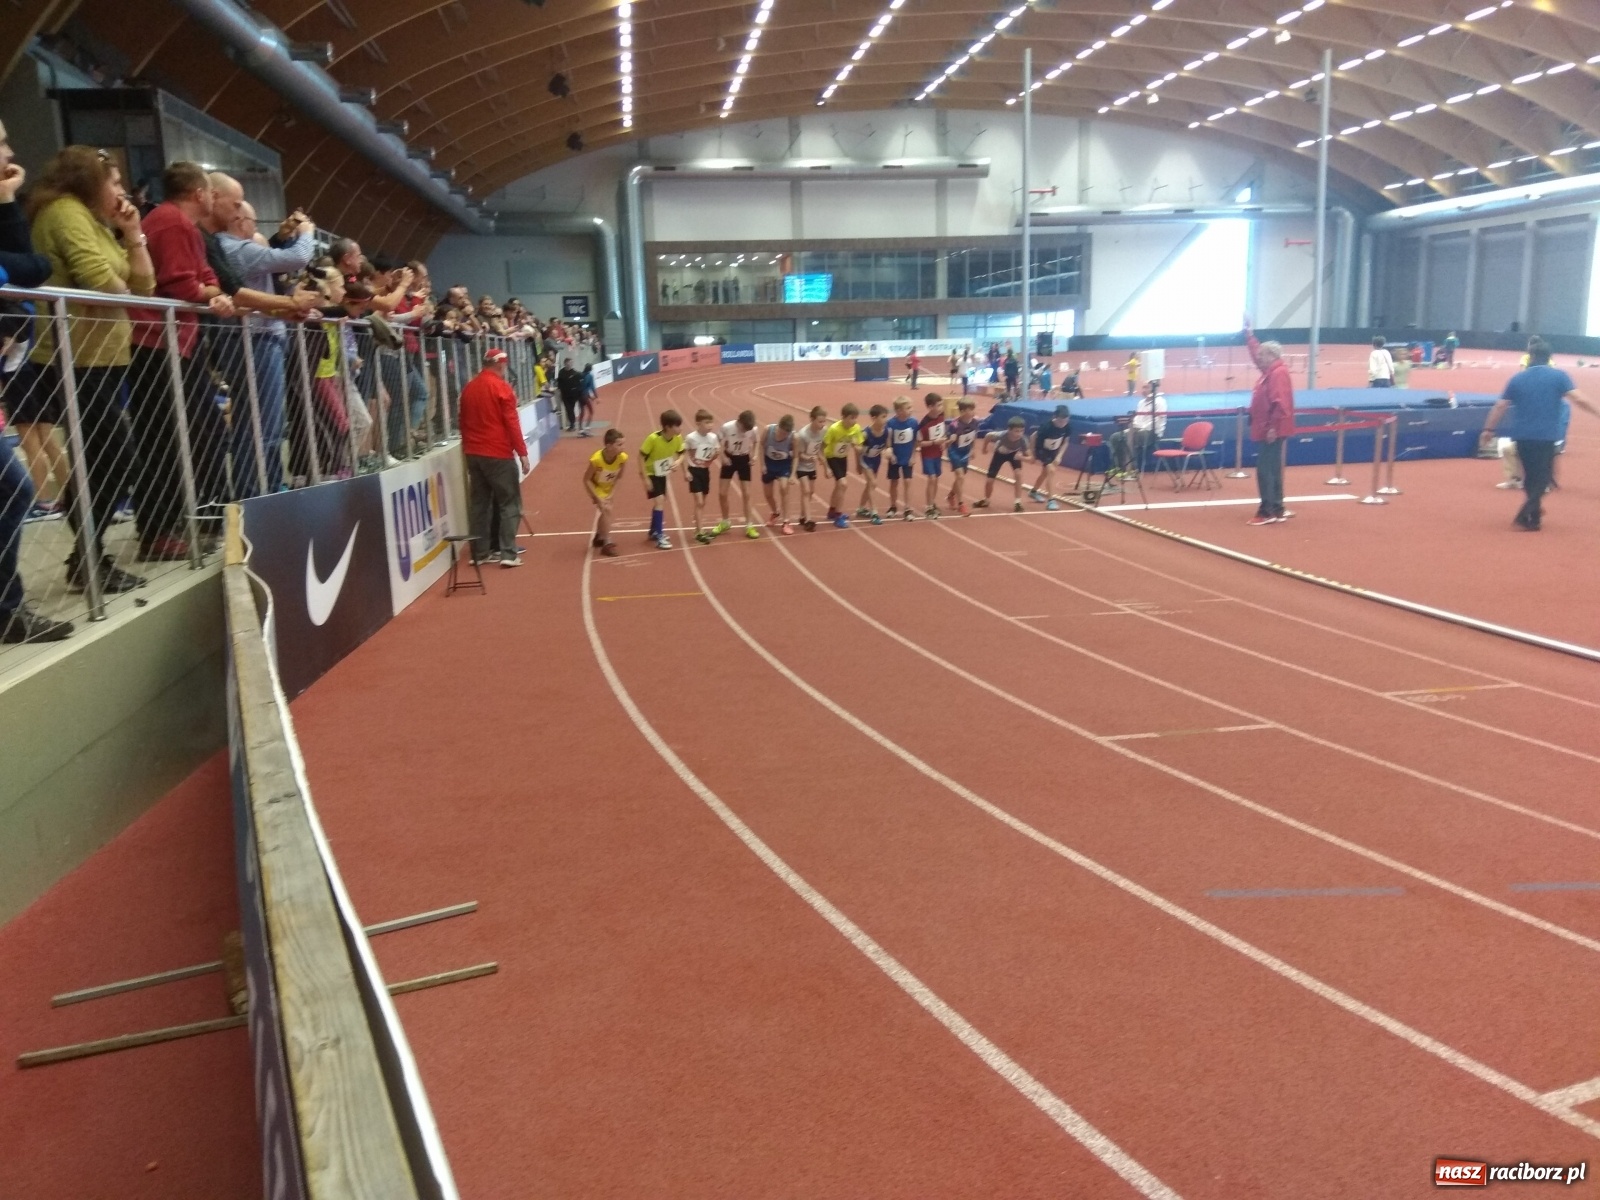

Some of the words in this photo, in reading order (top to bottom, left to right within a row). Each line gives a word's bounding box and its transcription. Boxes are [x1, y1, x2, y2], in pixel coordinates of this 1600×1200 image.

[568, 305, 586, 314] WC
[898, 431, 906, 441] 6
[733, 441, 743, 451] 11
